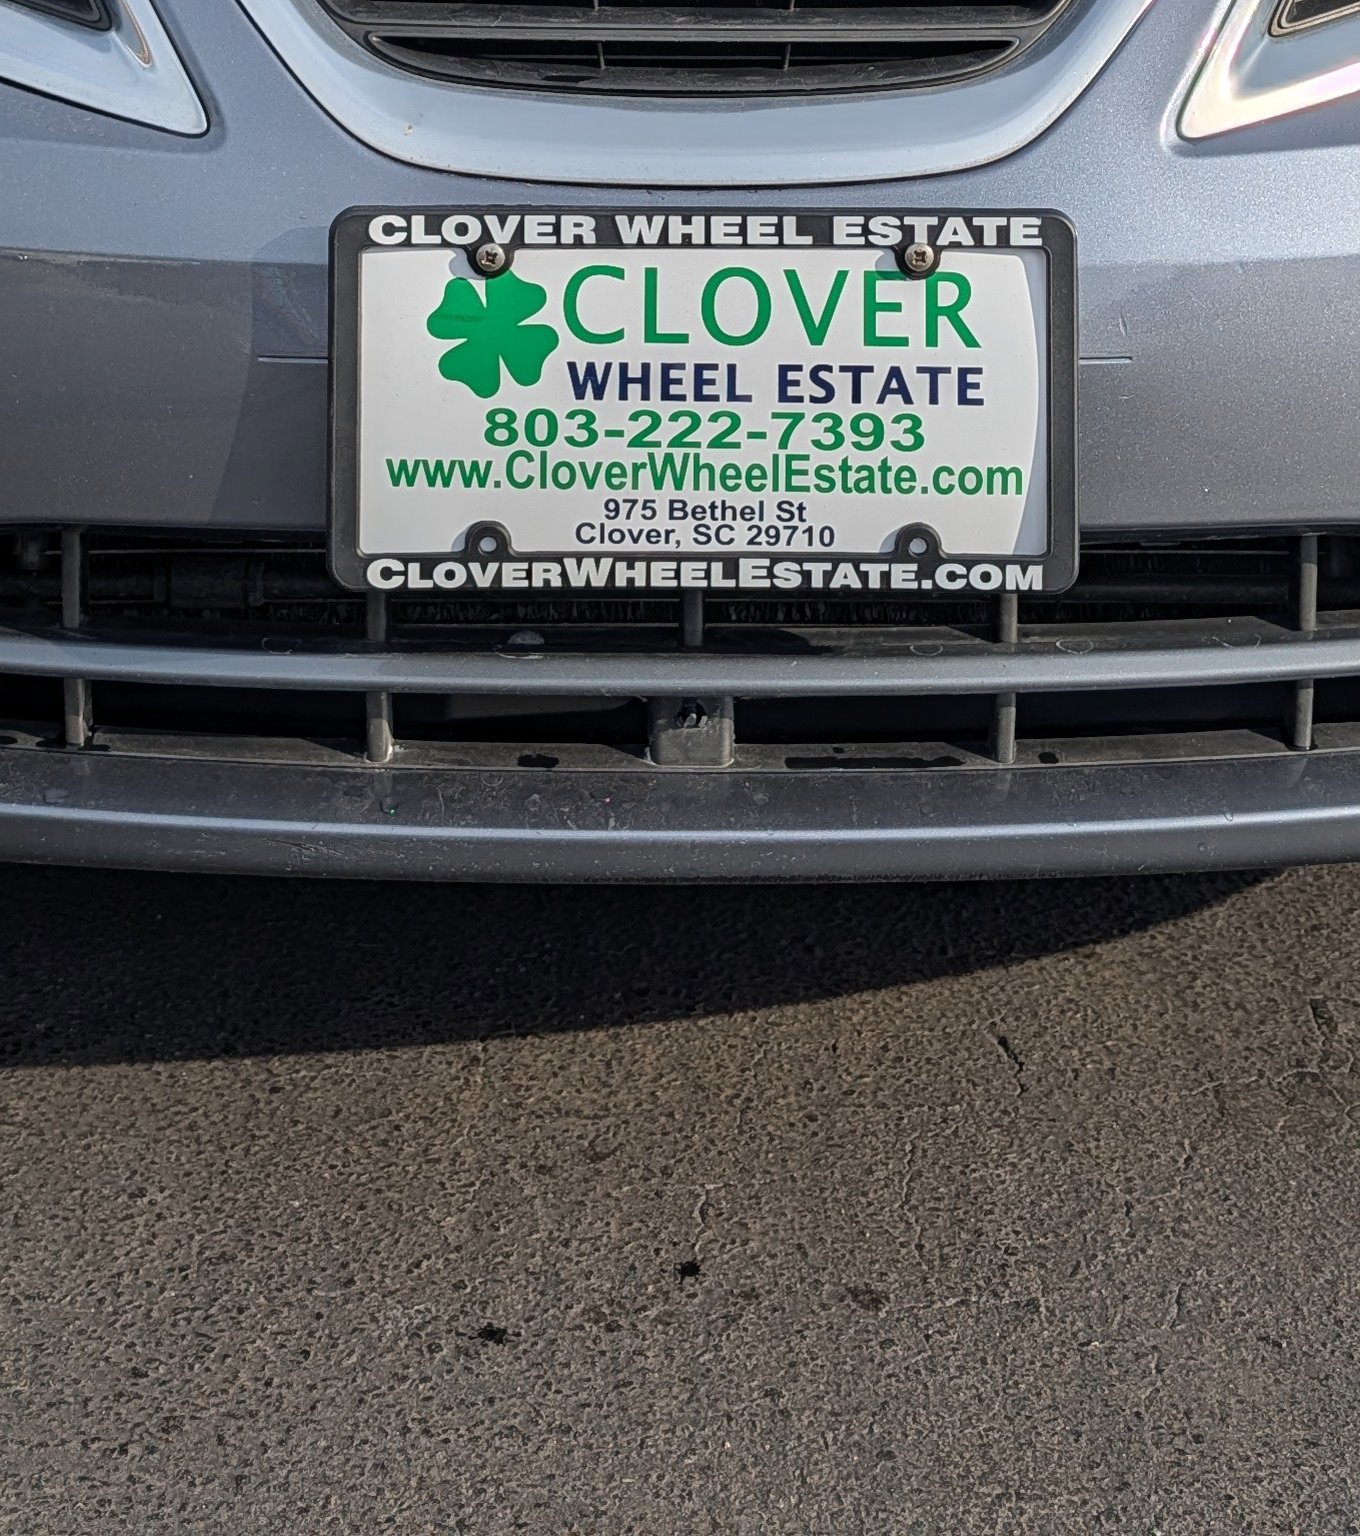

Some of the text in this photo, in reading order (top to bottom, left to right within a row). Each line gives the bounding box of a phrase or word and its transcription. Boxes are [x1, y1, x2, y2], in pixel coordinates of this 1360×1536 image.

[367, 215, 1042, 246] CLOVER WHEEL ESTATE
[562, 265, 982, 349] CLOVER
[567, 361, 985, 407] WHEEL ESTATE
[483, 407, 926, 453] 803-222-7393
[385, 449, 1023, 496] www.CloverWheelEstate.com
[603, 499, 807, 523] 975 Bethel St
[575, 523, 836, 548] Clover, SC 29710
